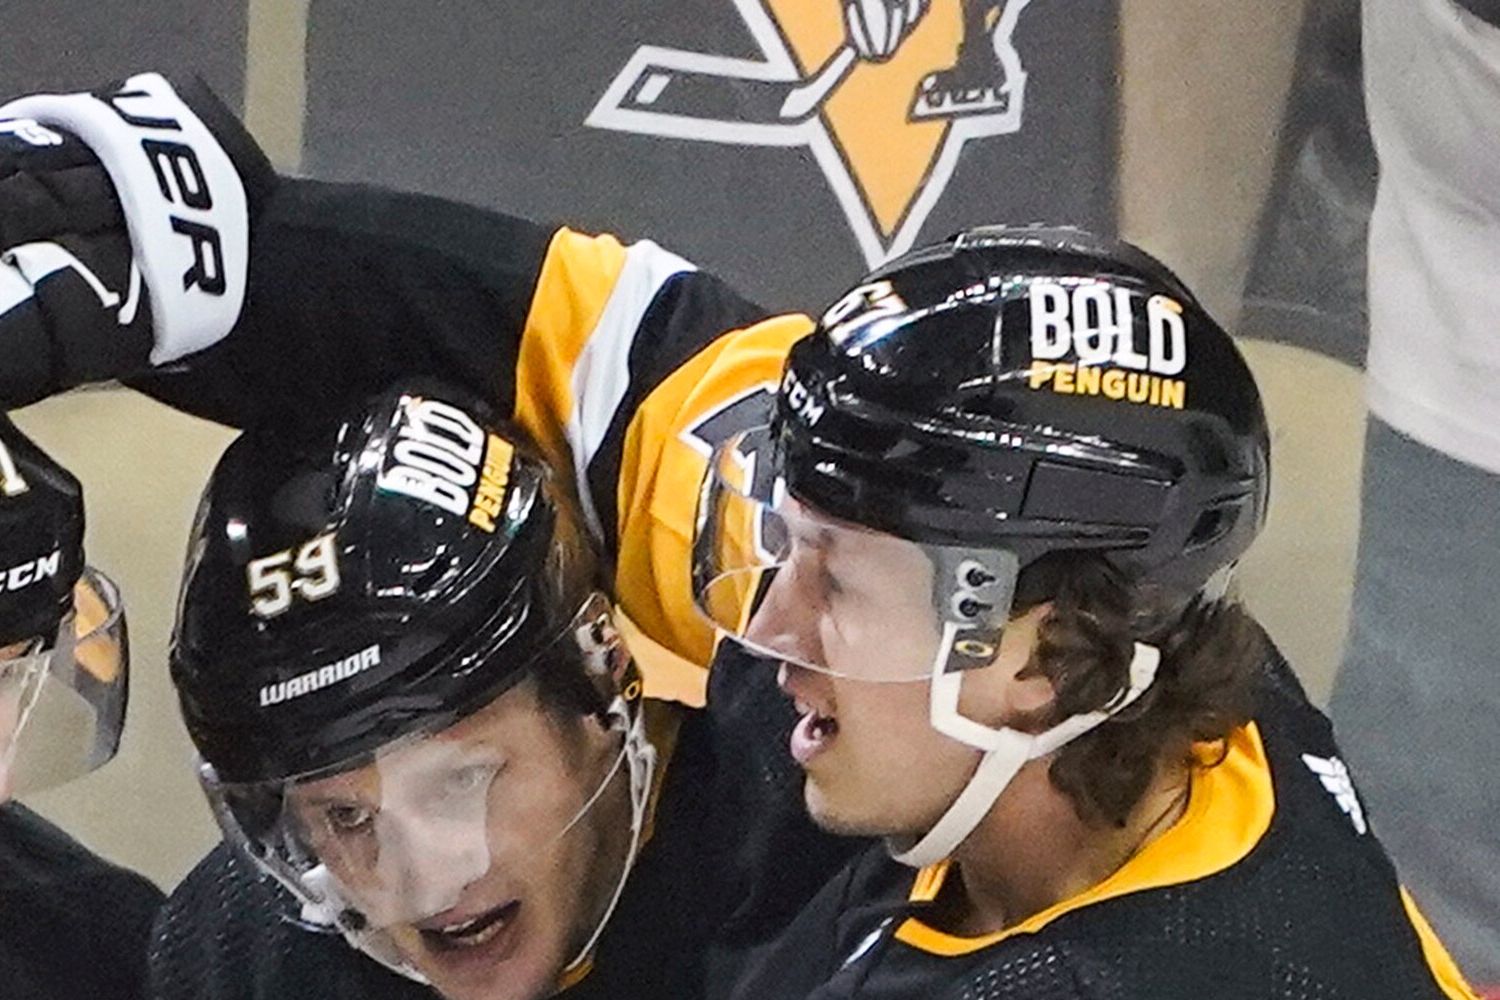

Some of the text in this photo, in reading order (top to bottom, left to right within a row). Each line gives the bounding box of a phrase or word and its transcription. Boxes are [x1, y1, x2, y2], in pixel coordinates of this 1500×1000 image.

[1029, 283, 1187, 376] BOLD
[1029, 360, 1186, 410] PENGUIN
[378, 398, 486, 516] BOLD
[469, 433, 515, 534] PENGUIN
[246, 531, 341, 619] 59
[260, 643, 381, 707] WARRIOR
